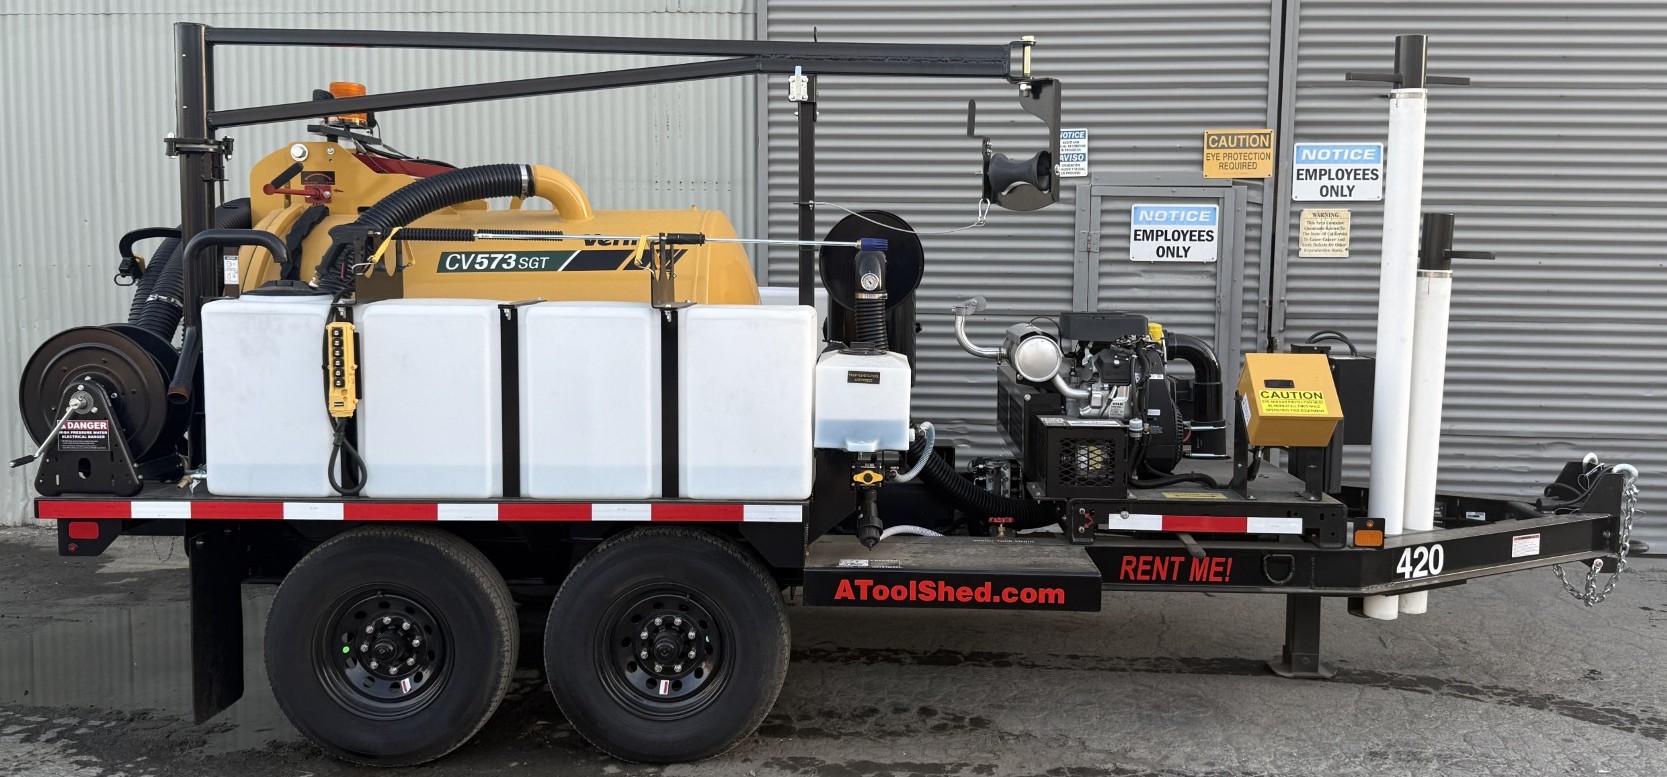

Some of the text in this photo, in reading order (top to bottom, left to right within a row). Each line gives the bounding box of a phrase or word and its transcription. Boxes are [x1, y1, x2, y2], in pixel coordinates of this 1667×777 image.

[1209, 134, 1270, 148] CAUTION
[1206, 152, 1271, 161] EYE PROTECTION
[1301, 149, 1376, 160] NOTICE
[1219, 161, 1258, 171] REQUIRED
[1296, 168, 1379, 181] EMPLOYEES
[1319, 185, 1355, 198] ONLY
[1138, 210, 1211, 222] NOTICE
[1133, 229, 1214, 242] EMPLOYEES
[1156, 245, 1191, 259] ONLY
[445, 253, 550, 270] CV573 SGT
[1260, 391, 1323, 400] CAUTION
[68, 422, 107, 430] DANGER
[1396, 543, 1444, 579] 420
[1119, 555, 1233, 582] RENT ME!
[834, 579, 1065, 604] AToolShed.com
